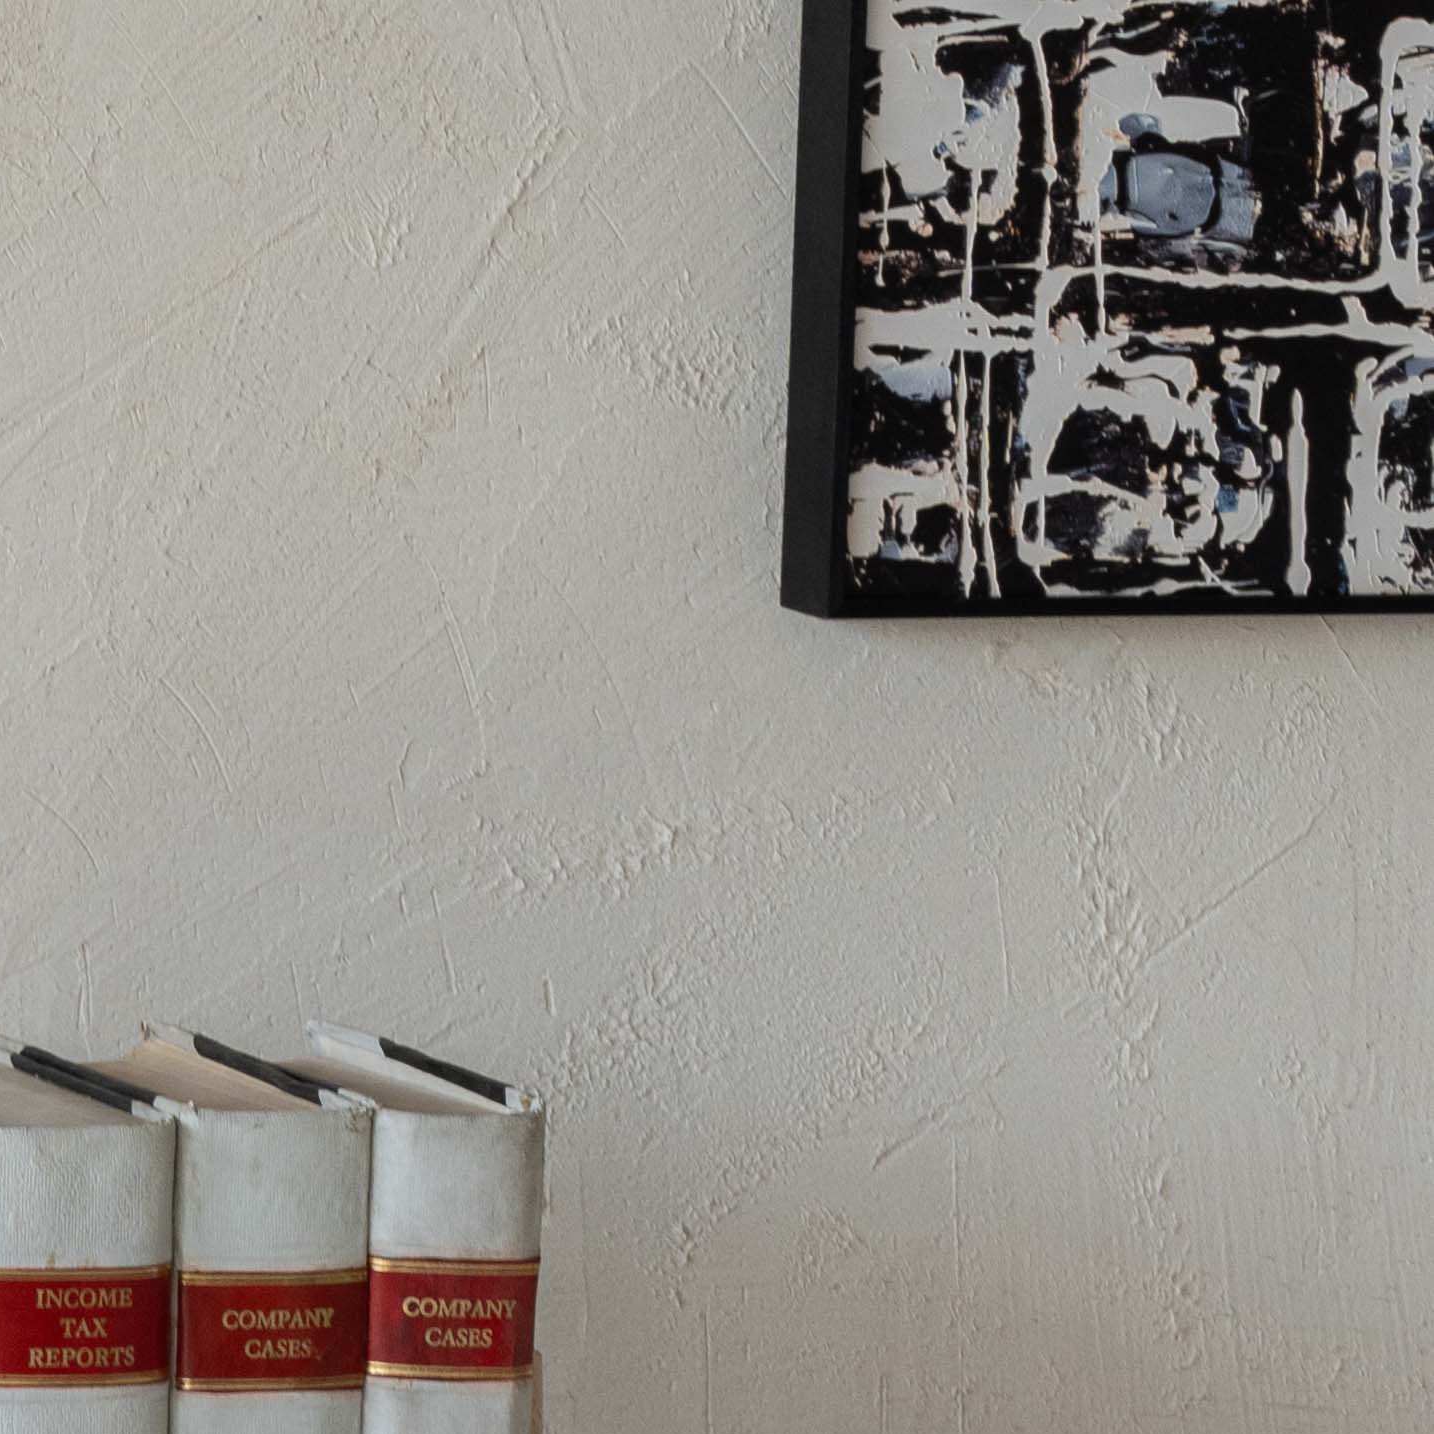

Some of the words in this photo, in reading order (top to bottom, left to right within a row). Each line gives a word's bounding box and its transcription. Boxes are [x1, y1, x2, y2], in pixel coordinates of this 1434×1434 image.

[35, 1288, 133, 1309] INCOME
[402, 1297, 516, 1318] COMPANY
[60, 1318, 108, 1339] TAX
[222, 1308, 334, 1330] COMPANY
[425, 1328, 492, 1348] CASES
[28, 1346, 135, 1368] REPORTS
[245, 1339, 312, 1360] CASES
